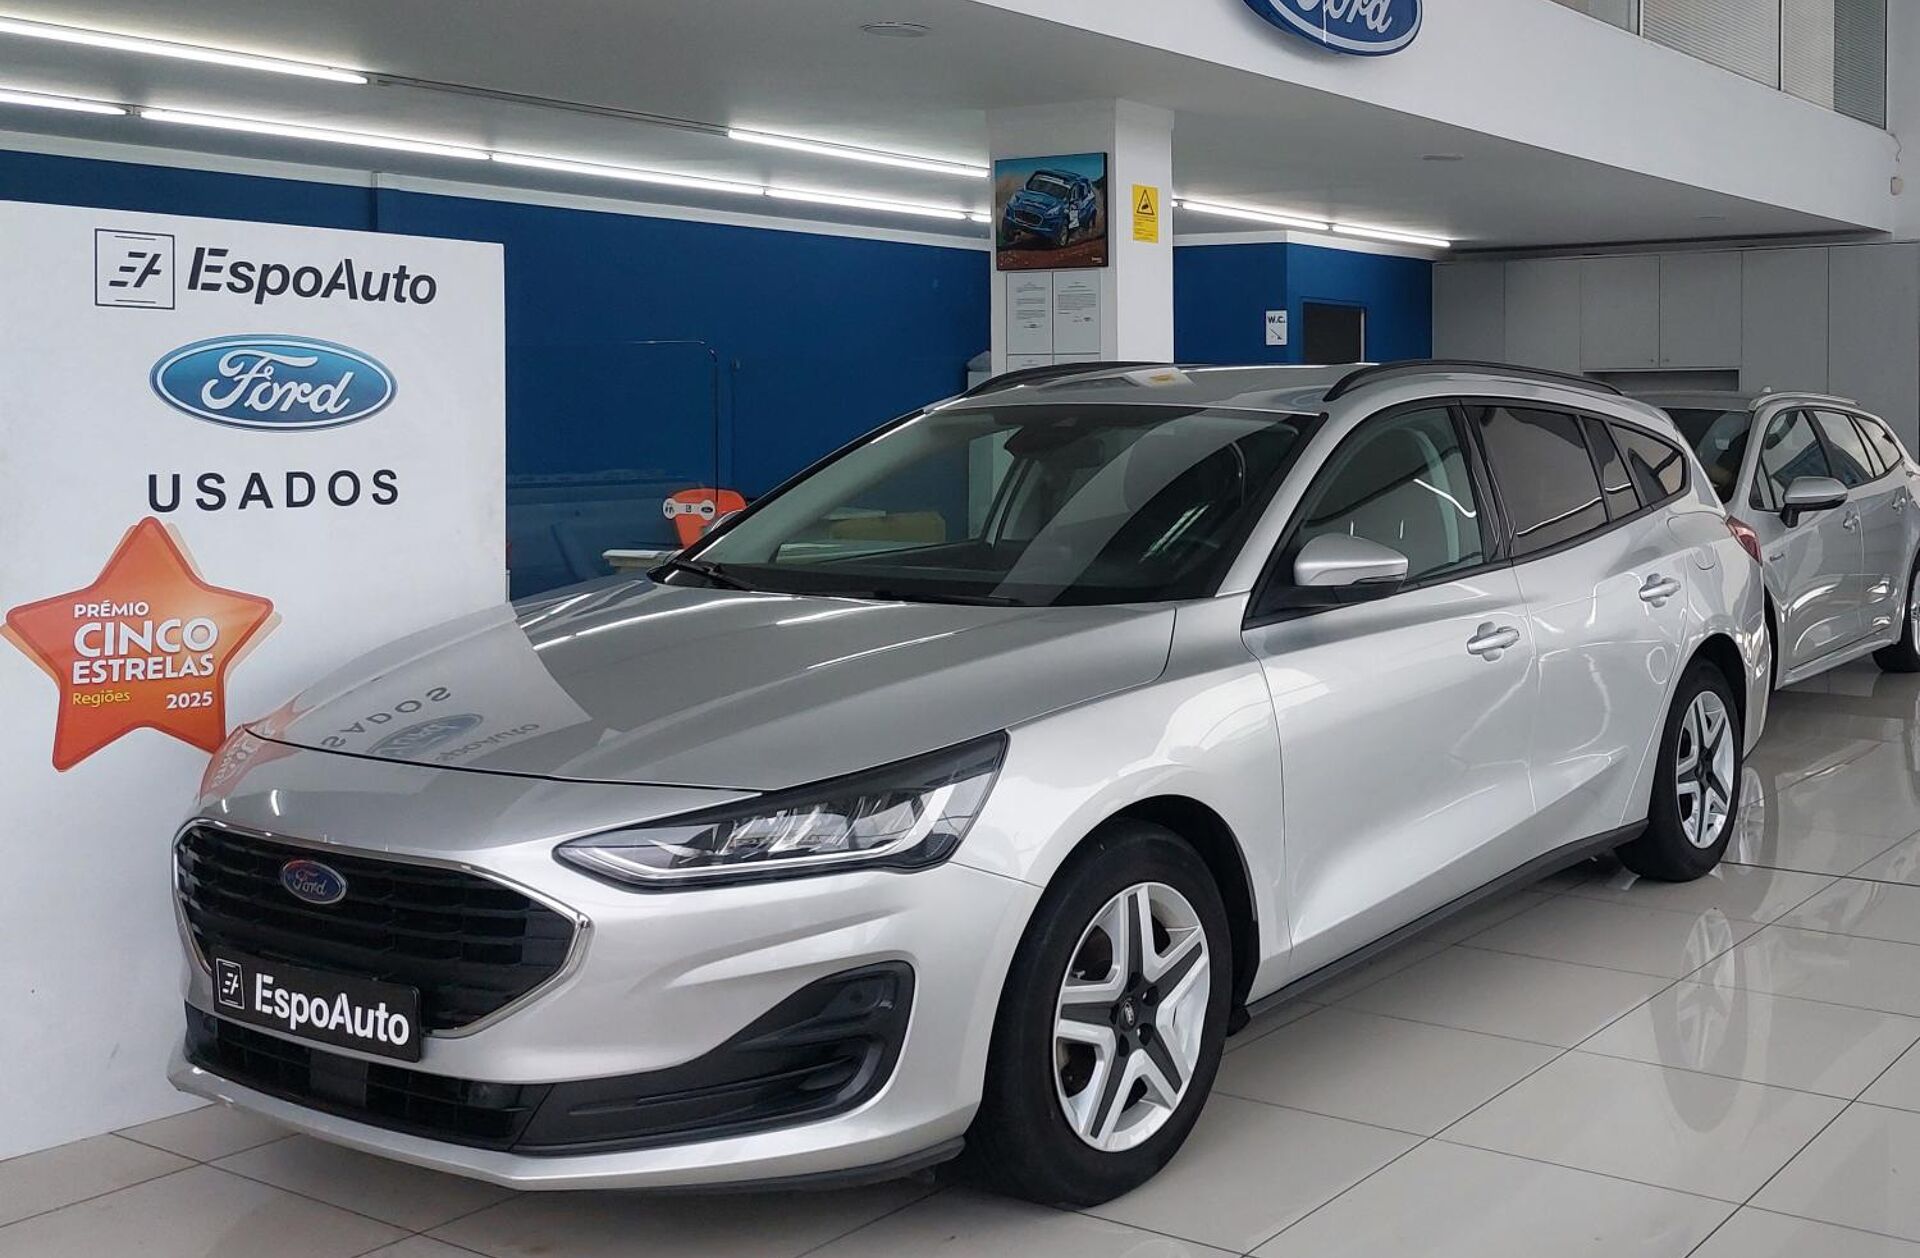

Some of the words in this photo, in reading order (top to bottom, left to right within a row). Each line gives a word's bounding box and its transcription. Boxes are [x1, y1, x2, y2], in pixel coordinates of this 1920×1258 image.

[1299, 0, 1393, 33] ord
[187, 246, 438, 305] EspoAuto
[200, 349, 354, 414] Ford
[148, 469, 399, 513] USADOS
[73, 600, 150, 618] PRÉMIO
[73, 617, 220, 658] CINCO
[72, 652, 215, 685] ESTRELAS
[72, 689, 132, 708] Regiões
[166, 690, 214, 710] 2025
[292, 869, 328, 896] Ford
[255, 972, 410, 1046] EspoAuto
